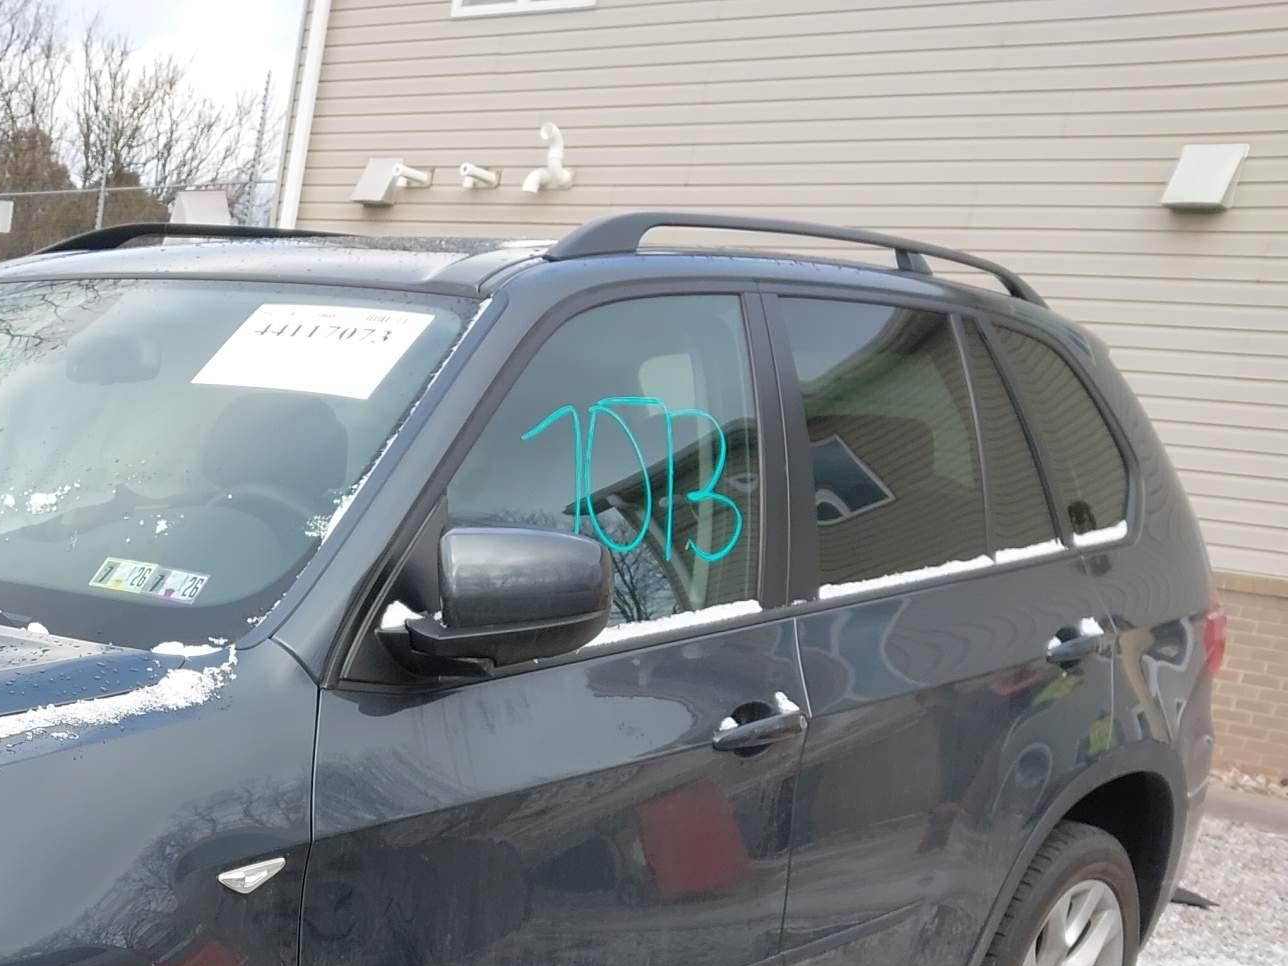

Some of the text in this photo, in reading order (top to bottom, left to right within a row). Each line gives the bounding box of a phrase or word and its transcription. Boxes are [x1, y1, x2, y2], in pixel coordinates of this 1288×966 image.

[255, 323, 392, 343] 44117073
[98, 566, 152, 588] 7 26
[149, 574, 205, 599] 7 26
